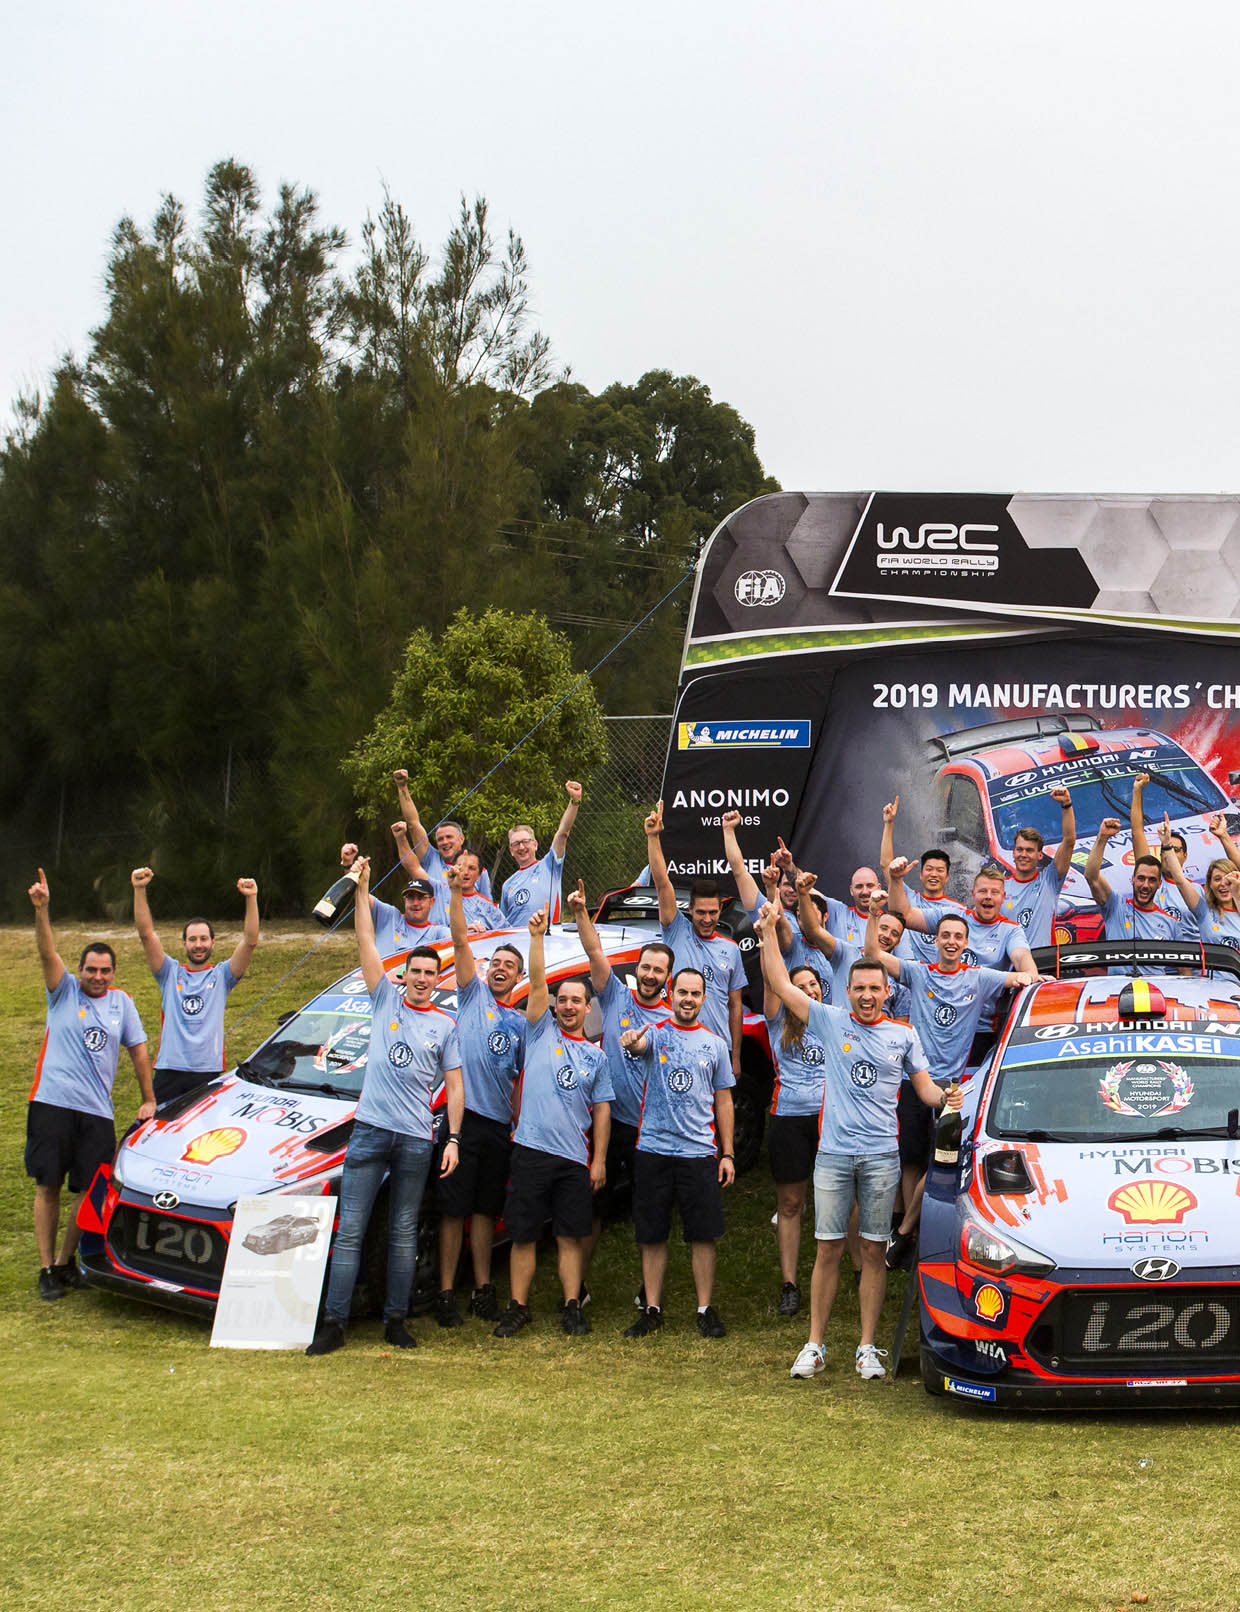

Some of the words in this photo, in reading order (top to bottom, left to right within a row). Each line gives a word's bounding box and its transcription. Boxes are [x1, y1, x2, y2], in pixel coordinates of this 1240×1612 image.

[877, 523, 999, 551] WRC
[872, 683, 938, 709] 2019
[715, 728, 799, 741] MICHELIN
[1042, 753, 1119, 777] HYUNDAI
[672, 788, 790, 809] ANONIMO
[1105, 952, 1201, 962] HYUNDAI
[1086, 1020, 1193, 1032] HYUNDAI
[1058, 1036, 1222, 1057] AsahiKASEI
[236, 1092, 302, 1109] HYUNDAI
[230, 1102, 328, 1133] MOBIS
[1079, 1148, 1186, 1159] HYUNDAI
[137, 1212, 213, 1264] i20
[1114, 1244, 1199, 1253] SYSTEMS
[1082, 1302, 1231, 1351] i20
[956, 1385, 991, 1397] MICHELIN
